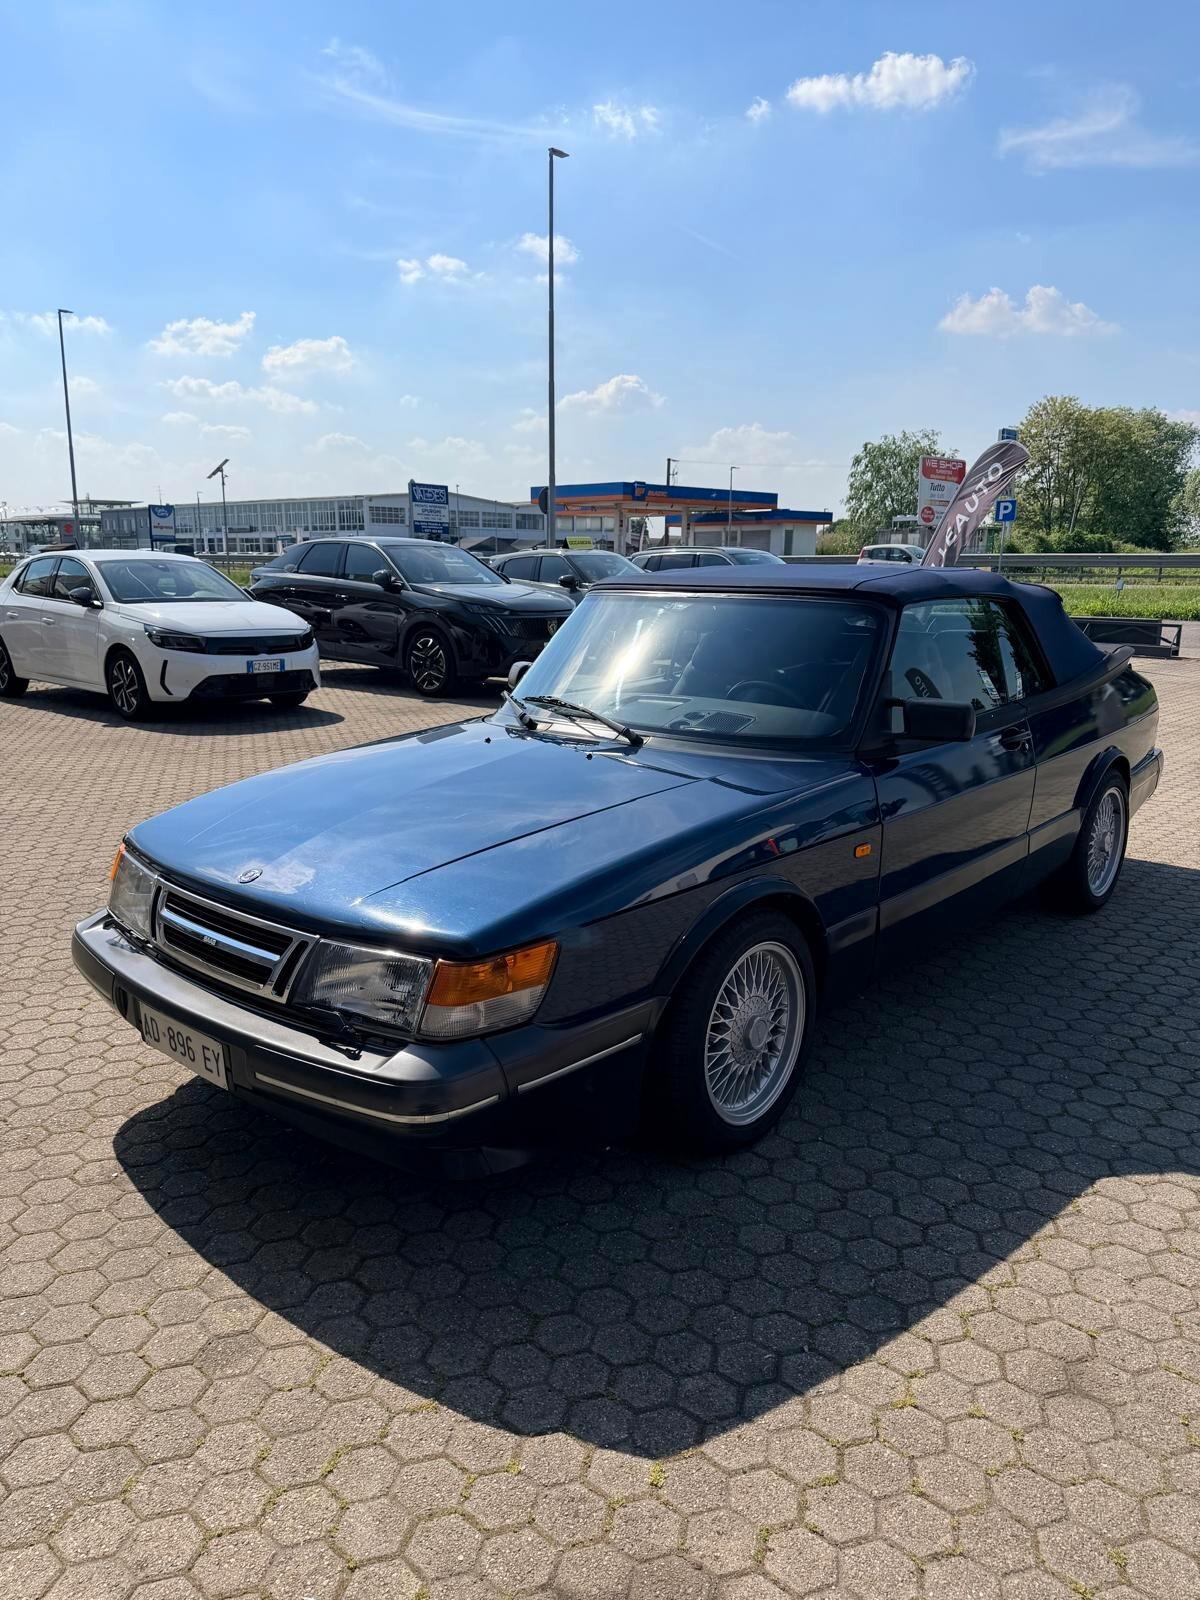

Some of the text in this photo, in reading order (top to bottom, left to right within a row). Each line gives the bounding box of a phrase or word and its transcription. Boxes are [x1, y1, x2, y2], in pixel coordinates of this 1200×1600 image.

[925, 459, 963, 471] WE SHOP
[930, 483, 946, 492] Tutto
[931, 462, 1003, 567] LEAUTO
[998, 502, 1013, 520] P
[143, 1013, 220, 1077] AD 896 EY
